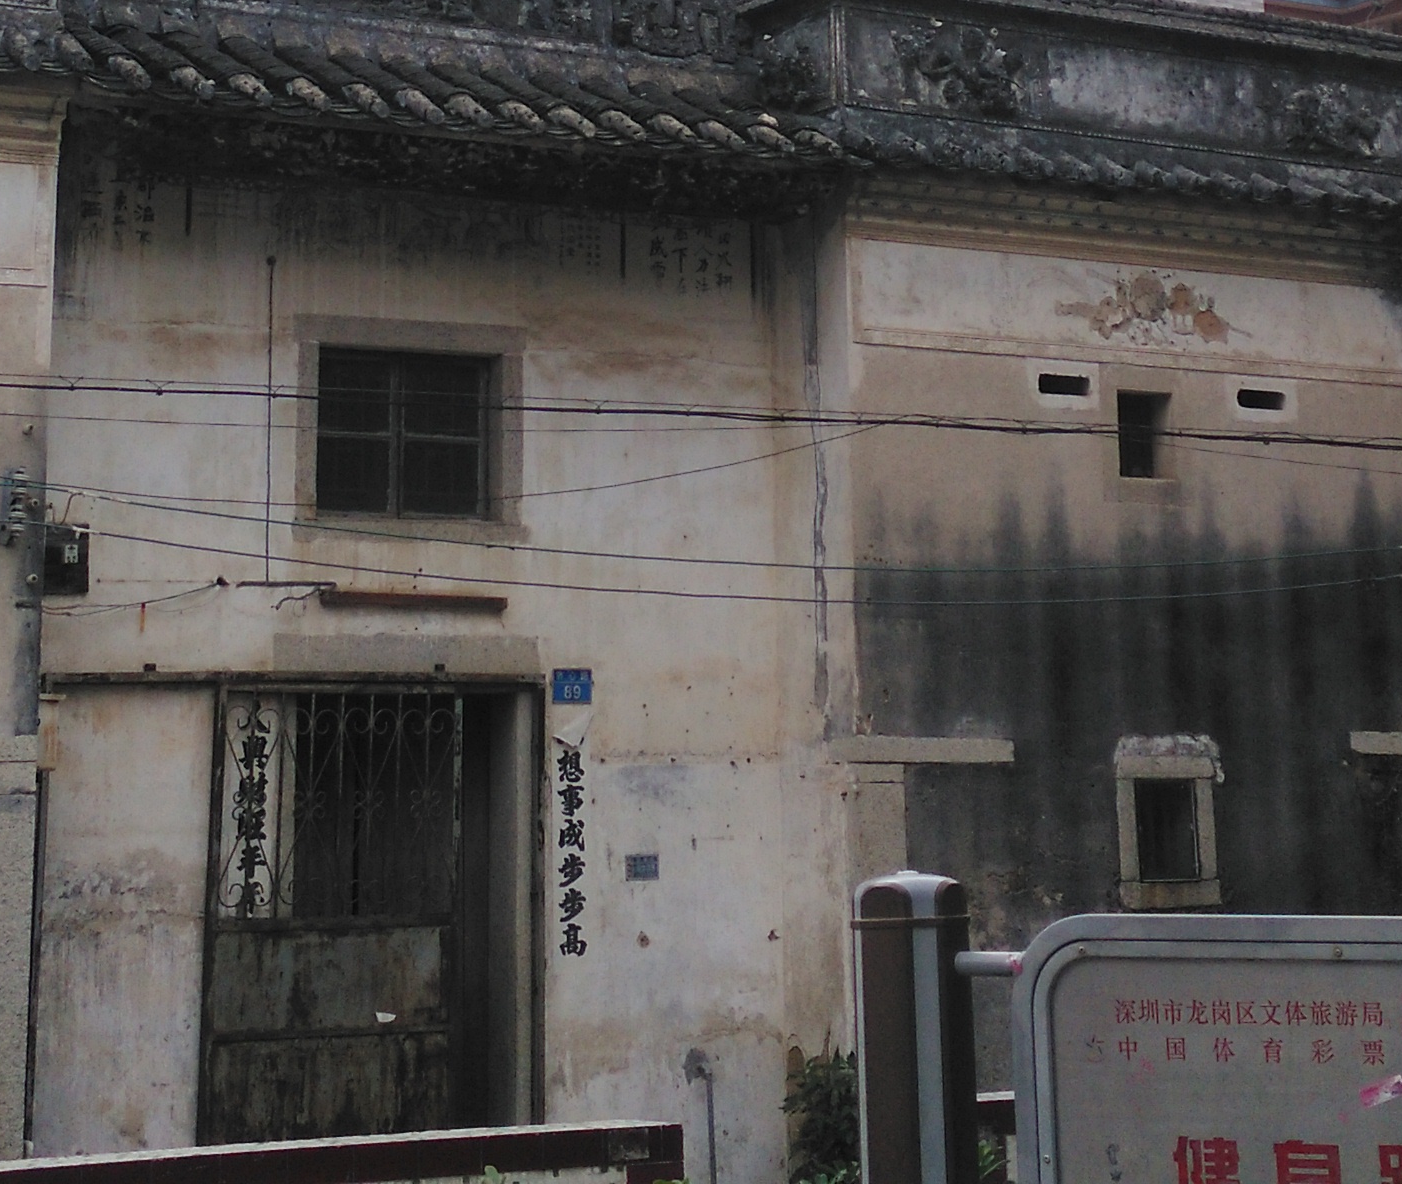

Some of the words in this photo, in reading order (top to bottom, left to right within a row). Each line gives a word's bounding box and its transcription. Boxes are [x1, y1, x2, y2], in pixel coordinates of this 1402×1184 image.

[564, 684, 582, 700] 89
[554, 737, 588, 958] 想事成步步高
[1114, 998, 1384, 1028] 深圳市龙岗区文体旅游局
[1117, 1036, 1386, 1065] 中国体育彩票
